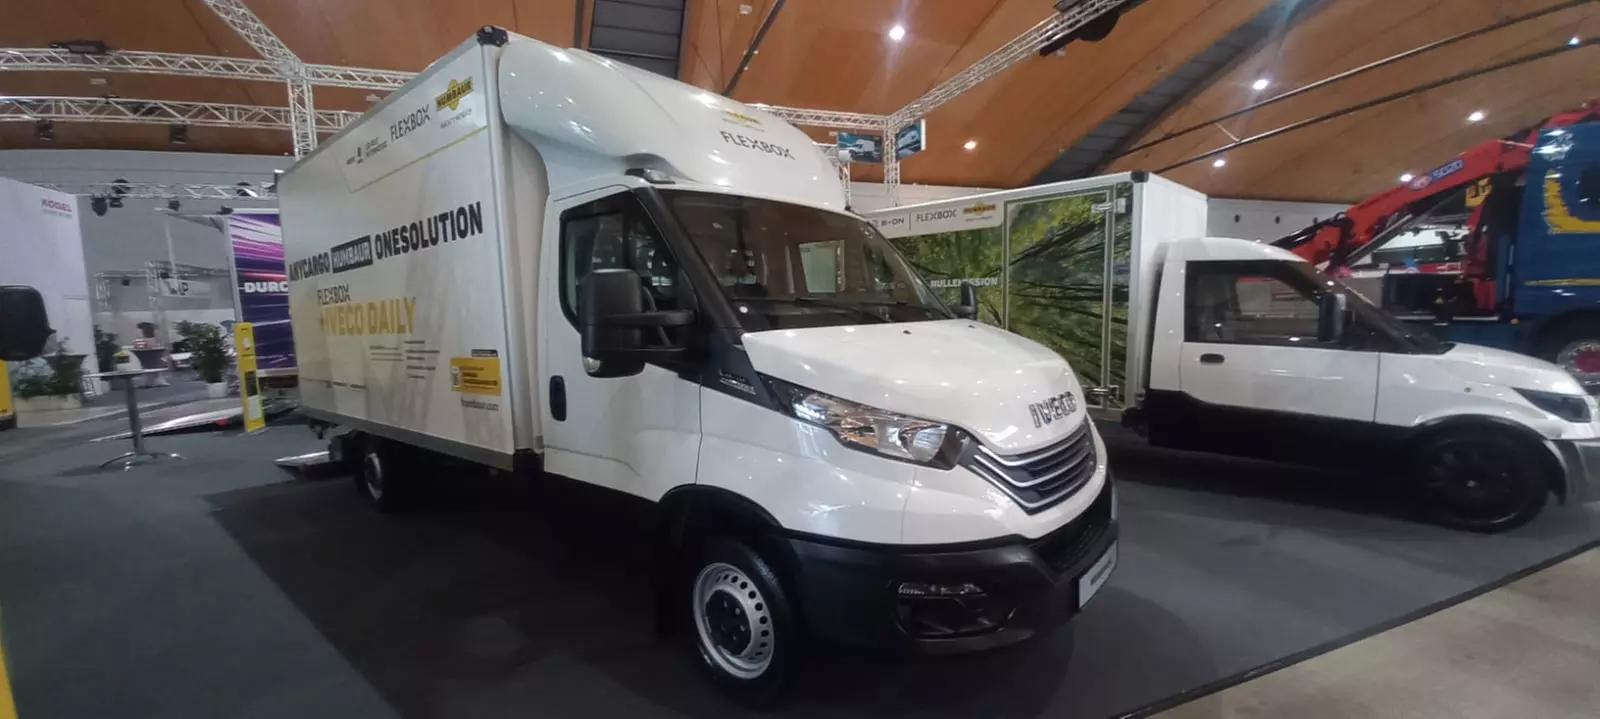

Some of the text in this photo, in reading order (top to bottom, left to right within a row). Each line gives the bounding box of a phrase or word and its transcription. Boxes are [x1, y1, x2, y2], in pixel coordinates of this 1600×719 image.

[390, 104, 431, 142] FLEXBOX
[720, 131, 795, 160] FLEXBOX
[916, 208, 957, 222] FLEXBOX
[289, 201, 483, 281] ANYCARGO HUMBAUR ONESOLUTION
[316, 284, 351, 306] FLEXBOX
[367, 296, 417, 334] DAILY
[1028, 391, 1077, 428] IVECO
